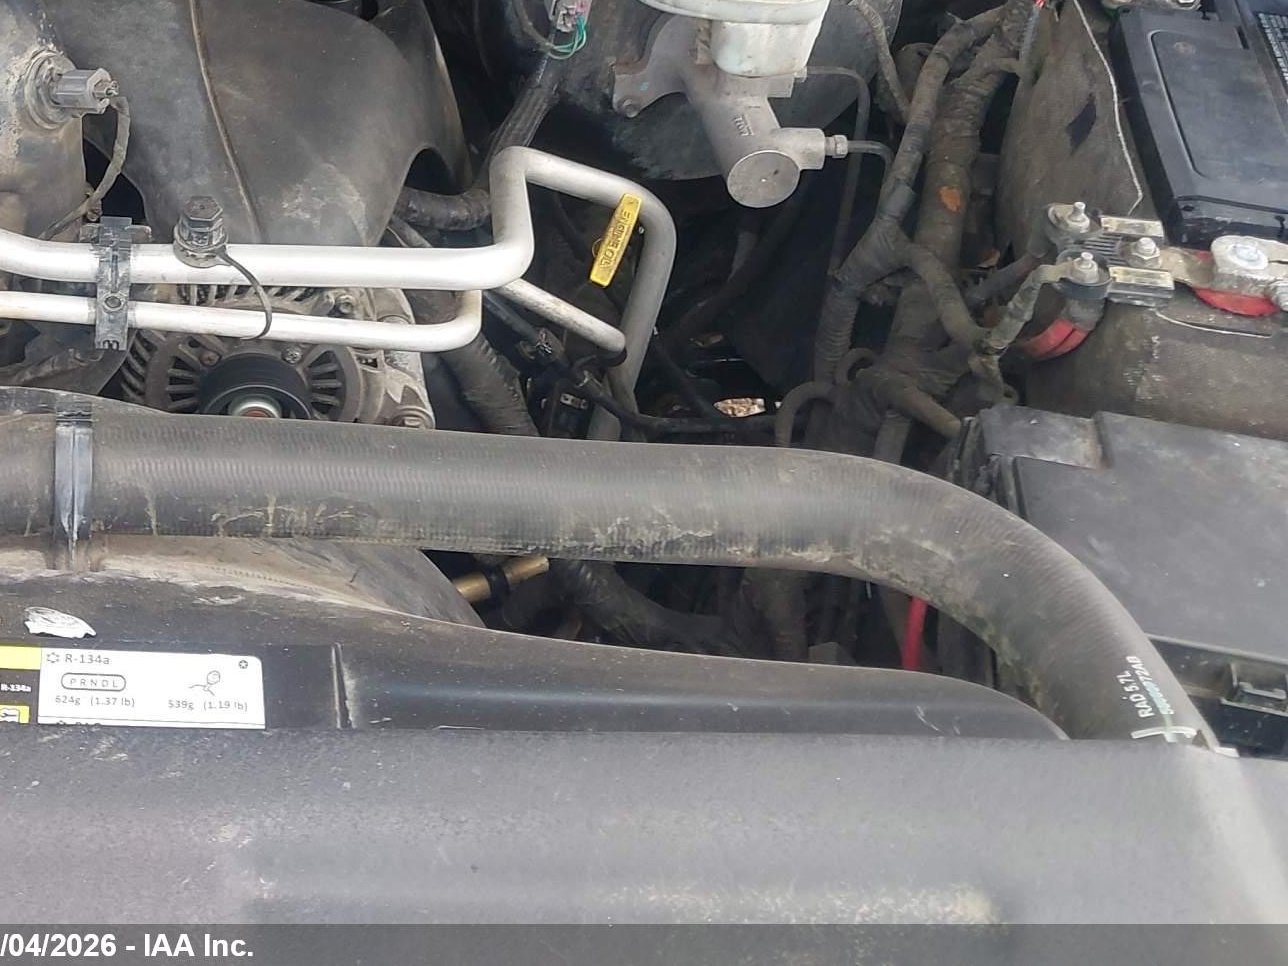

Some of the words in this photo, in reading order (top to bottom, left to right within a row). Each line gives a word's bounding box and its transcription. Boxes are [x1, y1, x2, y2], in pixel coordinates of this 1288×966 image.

[64, 653, 110, 665] R-134a
[1116, 670, 1140, 692] 5.7L
[55, 695, 81, 706] 624g
[90, 695, 118, 707] (1.37
[120, 697, 135, 708] lb)
[168, 698, 194, 711] 539g
[203, 700, 231, 712] (1.19
[233, 701, 248, 712] lb)
[1129, 694, 1155, 718] RAD
